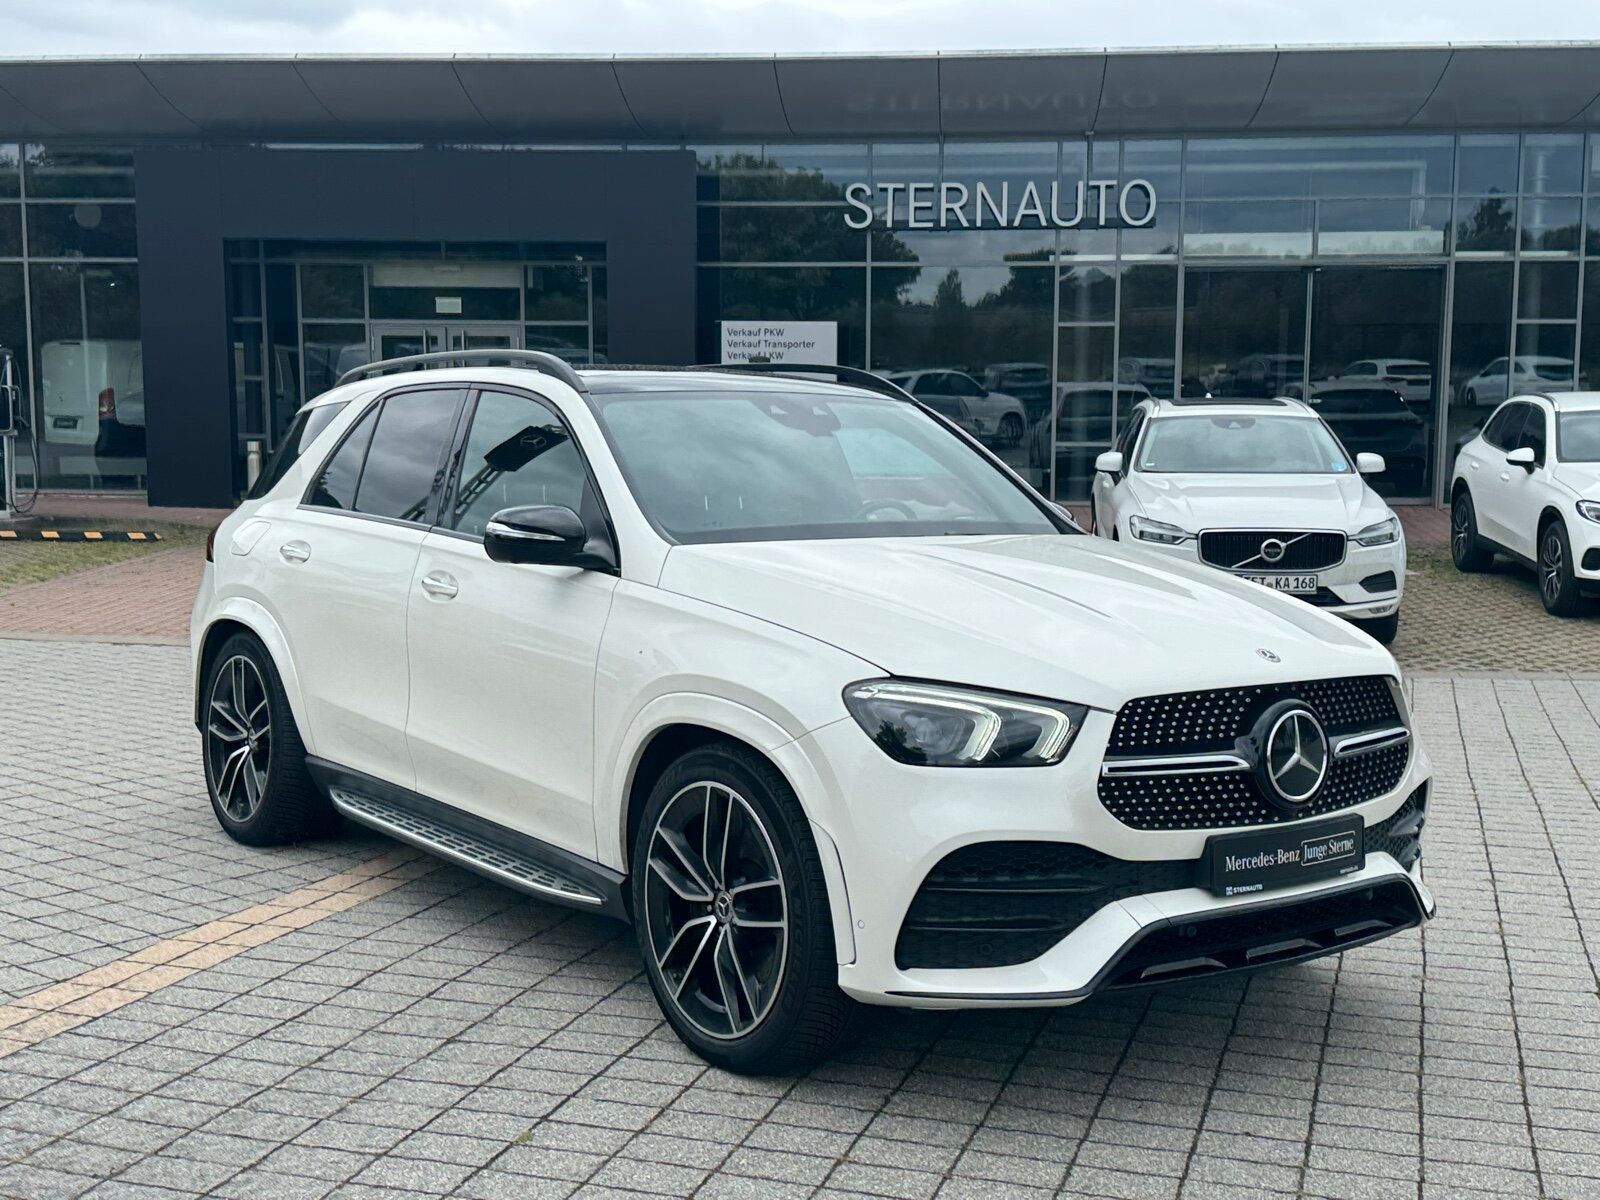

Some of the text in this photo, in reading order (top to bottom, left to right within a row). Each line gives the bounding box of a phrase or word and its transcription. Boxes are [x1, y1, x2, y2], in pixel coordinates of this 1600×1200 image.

[843, 179, 1157, 229] STERNAUTO
[727, 328, 785, 337] Verkauf PKW
[727, 340, 816, 350] Verkauf Transporter
[1275, 577, 1290, 589] KA
[1293, 577, 1315, 589] 168
[1225, 837, 1354, 872] Mercedes-Benz Junge Sterne
[1233, 883, 1263, 894] STERNAUTO
